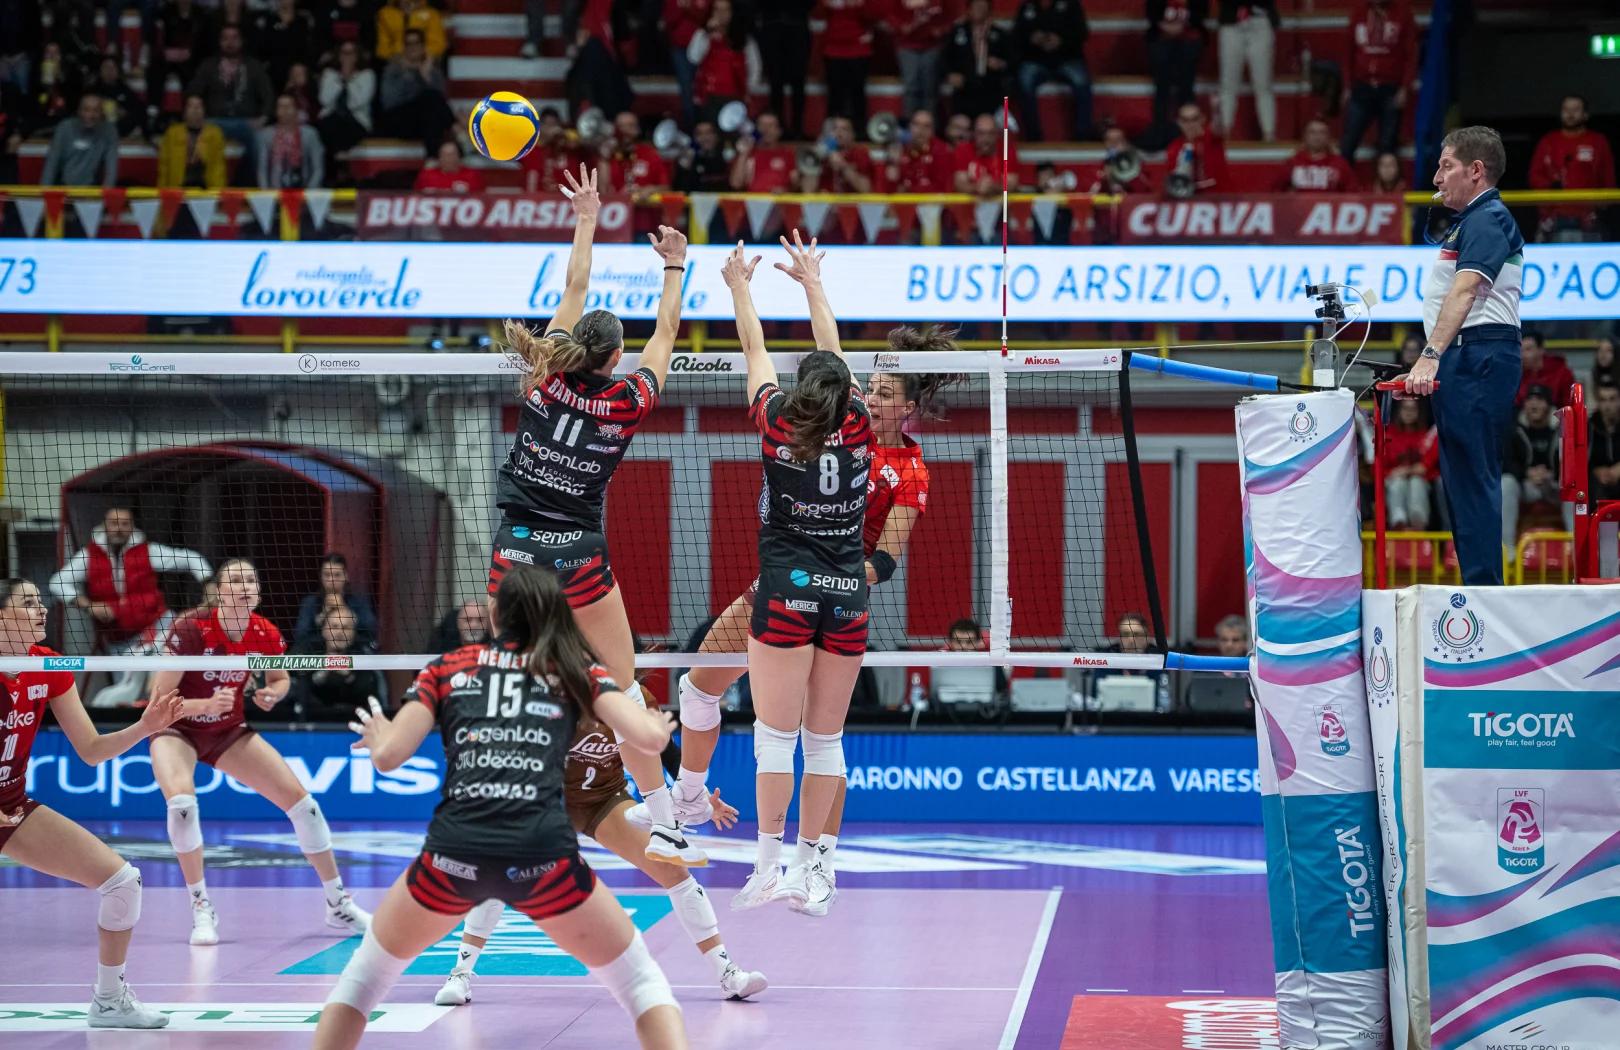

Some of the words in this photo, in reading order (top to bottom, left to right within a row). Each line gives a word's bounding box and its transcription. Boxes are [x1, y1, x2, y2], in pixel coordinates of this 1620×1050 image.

[366, 197, 483, 227] BUSTO
[485, 199, 628, 230] ARSIO
[1128, 202, 1273, 236] CURVA
[1301, 202, 1396, 235] ADF
[0, 258, 37, 294] 73
[241, 250, 421, 309] loroverde
[906, 263, 1040, 303] BUSTO
[1053, 263, 1231, 310] ARSIZIO,
[671, 355, 732, 372] Ricola
[548, 378, 611, 416] BARTOLINI
[552, 413, 584, 448] 11
[522, 432, 601, 474] CogenLab
[819, 453, 840, 496] 8
[281, 657, 322, 669] MAMMA
[486, 673, 524, 717] 15
[455, 725, 551, 746] CogenLab
[1487, 739, 1503, 747] play
[1505, 739, 1519, 747] fair,
[1536, 739, 1556, 748] good
[477, 749, 544, 772] decora
[582, 766, 596, 790] 2
[847, 766, 963, 791] ARONNO
[977, 766, 1156, 792] CASTELLANZA
[1168, 767, 1261, 793] VARESE
[1365, 845, 1374, 865] good
